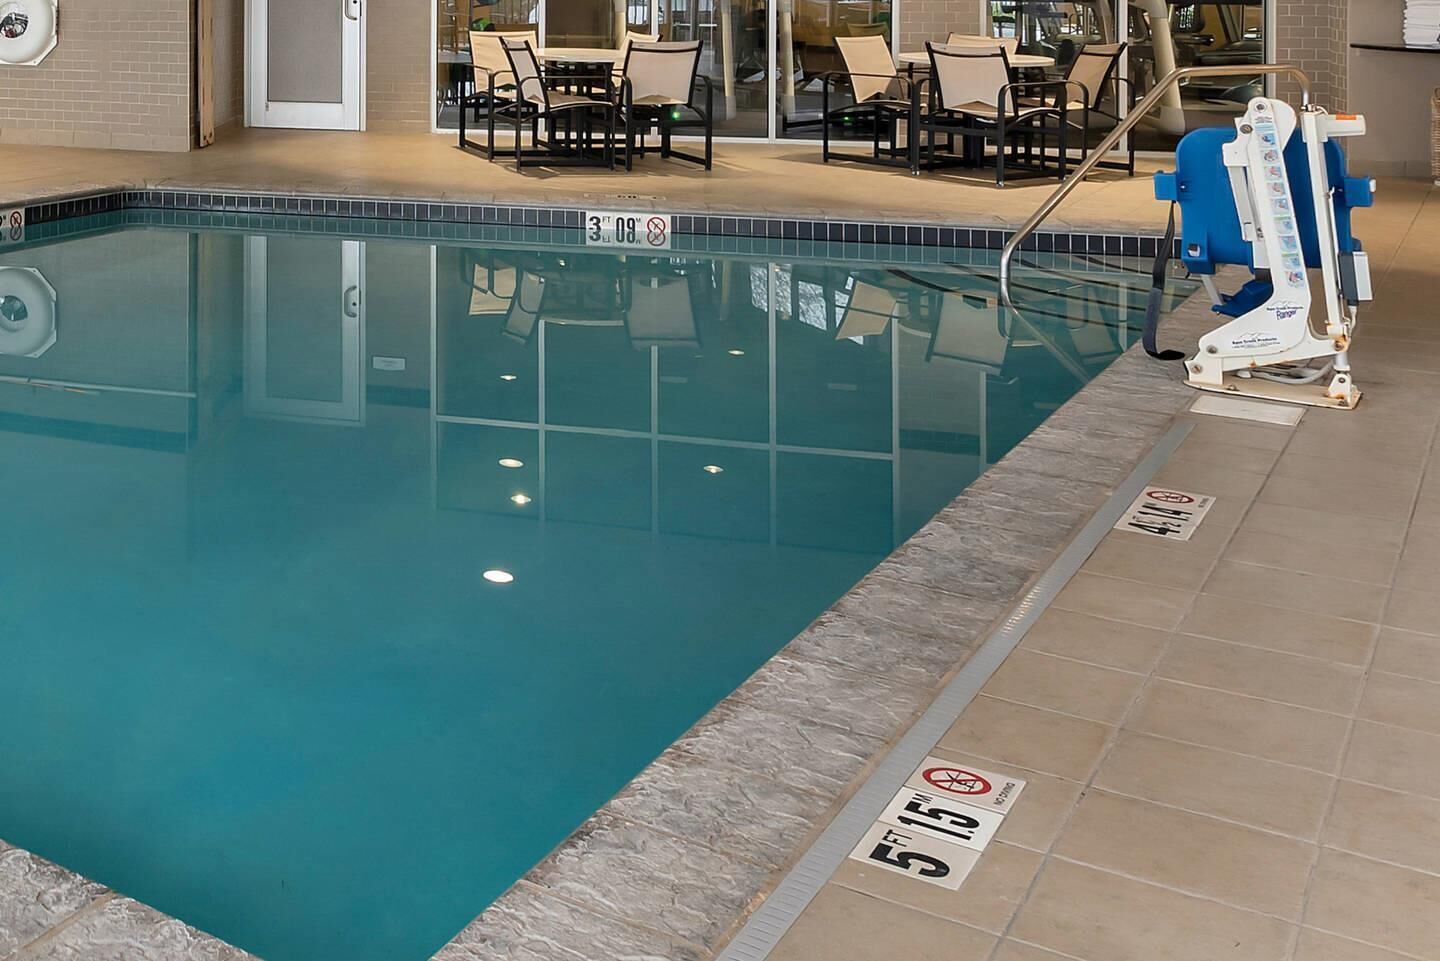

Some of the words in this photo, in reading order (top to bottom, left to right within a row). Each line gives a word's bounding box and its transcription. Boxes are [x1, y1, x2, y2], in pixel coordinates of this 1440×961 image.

[589, 216, 601, 232] 3
[915, 793, 934, 805] M
[882, 829, 913, 848] FT
[868, 842, 950, 878] 5
